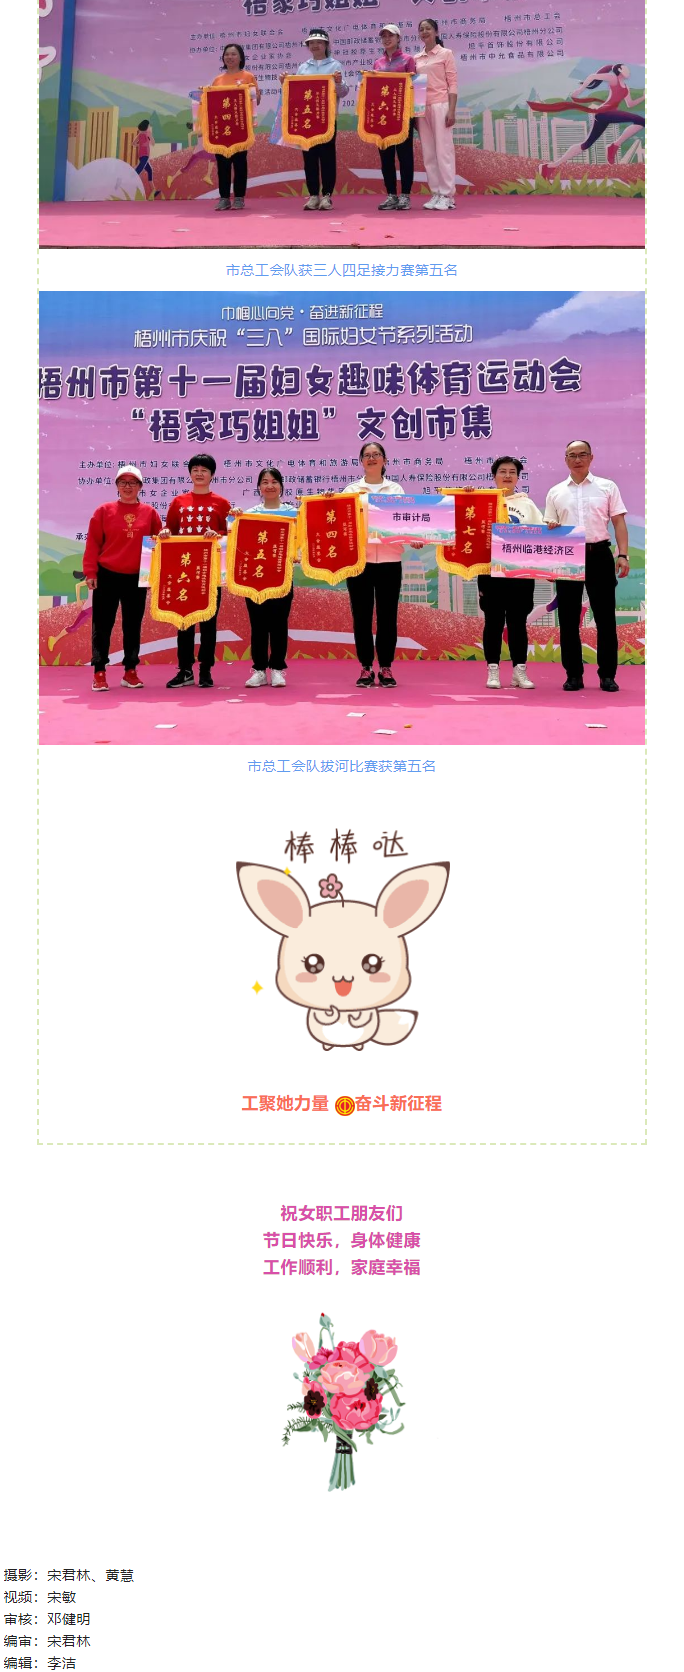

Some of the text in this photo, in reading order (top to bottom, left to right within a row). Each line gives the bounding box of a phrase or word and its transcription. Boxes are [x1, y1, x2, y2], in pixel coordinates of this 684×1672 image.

[222, 96, 232, 136] 第四名
[302, 88, 313, 129] 第五名
[378, 84, 390, 126] 第六名
[221, 304, 383, 321] 巾帼心向党·奋进新征程
[39, 356, 581, 400] 梧州市第十一届妇女趣味体育运动会
[326, 509, 338, 559] 第四名
[392, 512, 431, 522] 市审计局
[461, 505, 476, 555] 第七名
[252, 530, 270, 579] 第五名
[502, 543, 575, 556] 梧州临港经济区
[176, 551, 192, 602] 第六名
